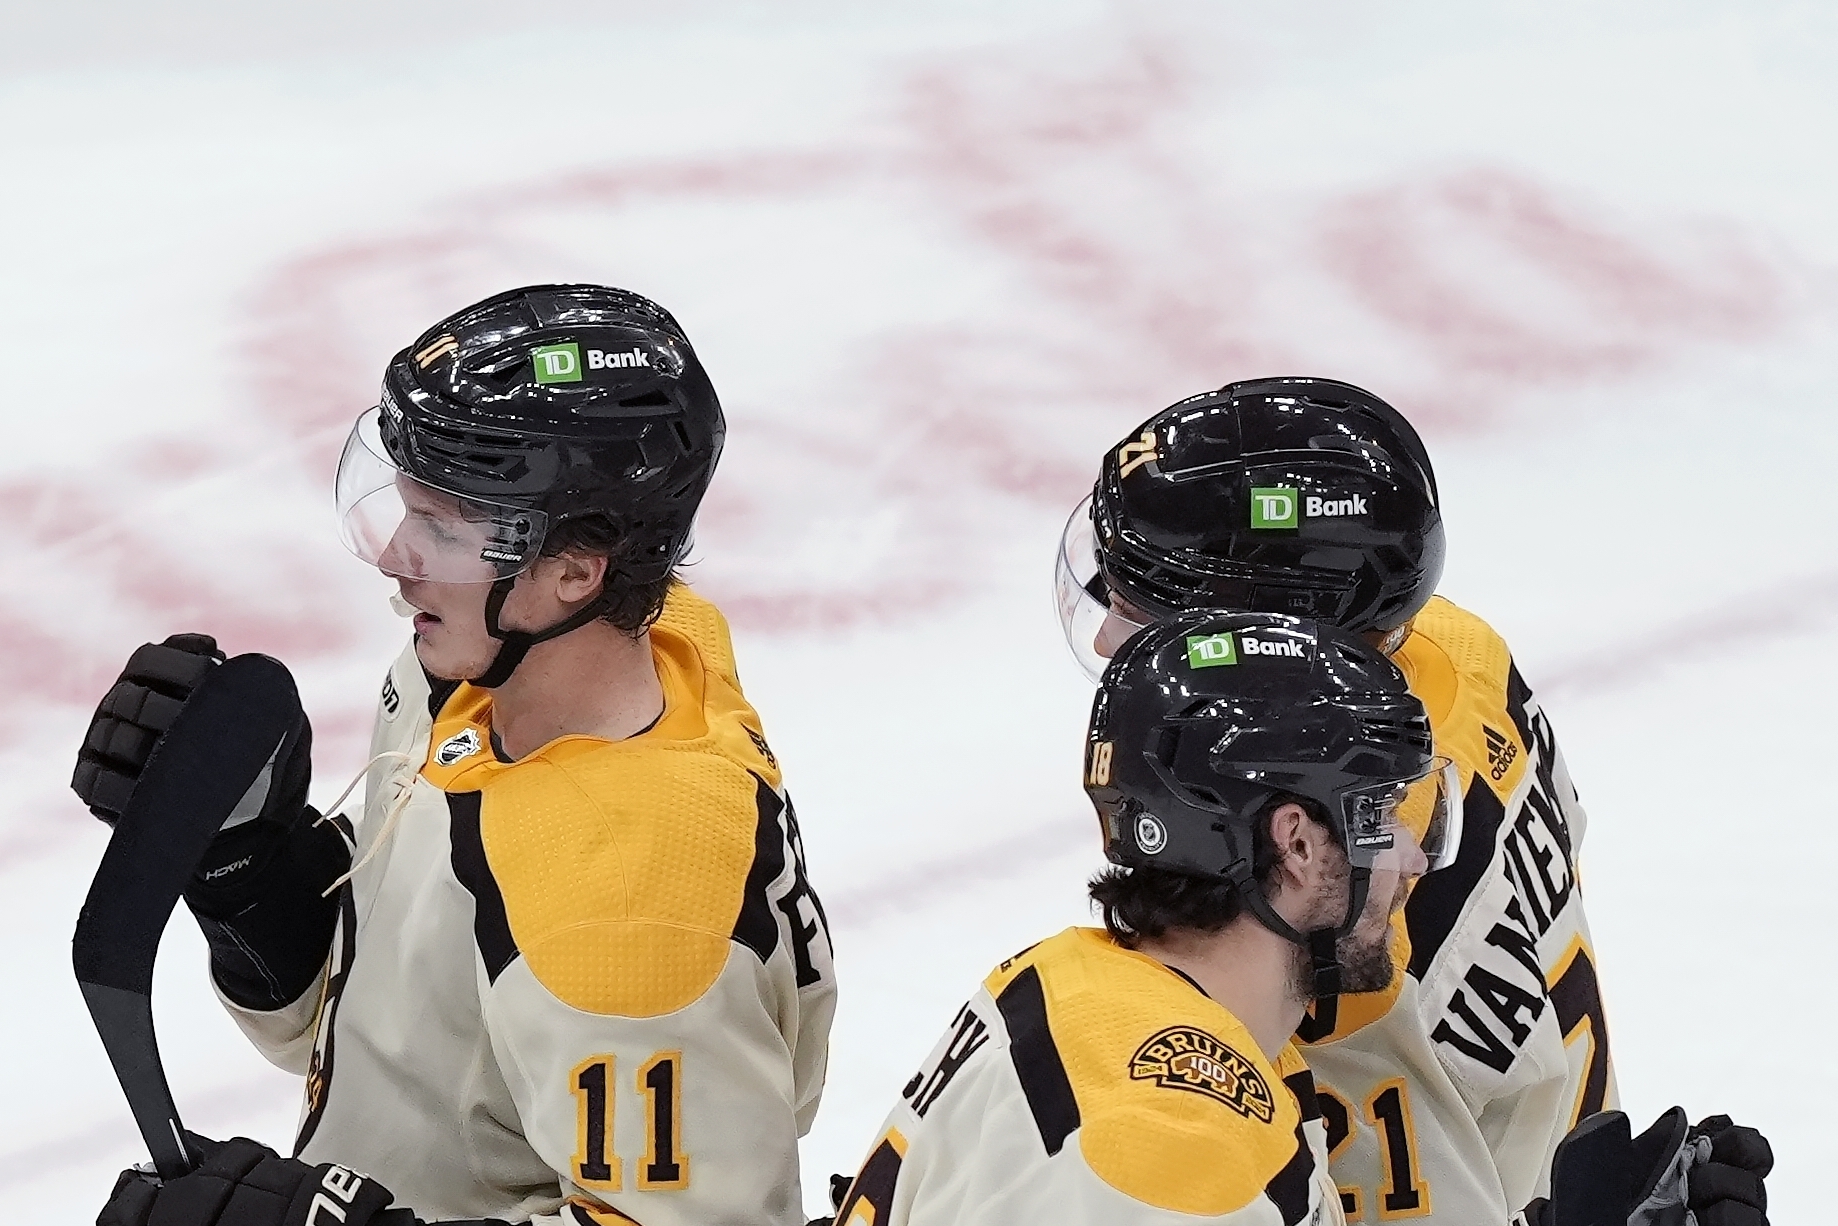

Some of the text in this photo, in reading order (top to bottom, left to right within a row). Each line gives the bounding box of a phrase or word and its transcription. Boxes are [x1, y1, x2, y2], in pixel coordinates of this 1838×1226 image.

[587, 348, 651, 370] Bank
[1118, 431, 1158, 480] 21
[1305, 494, 1368, 517] Bank
[1241, 637, 1306, 659] Bank
[1089, 740, 1114, 788] 18
[1490, 742, 1519, 783] adidas
[1145, 1032, 1265, 1096] BRUINS
[1190, 1056, 1227, 1083] 100
[569, 1048, 691, 1193] 11
